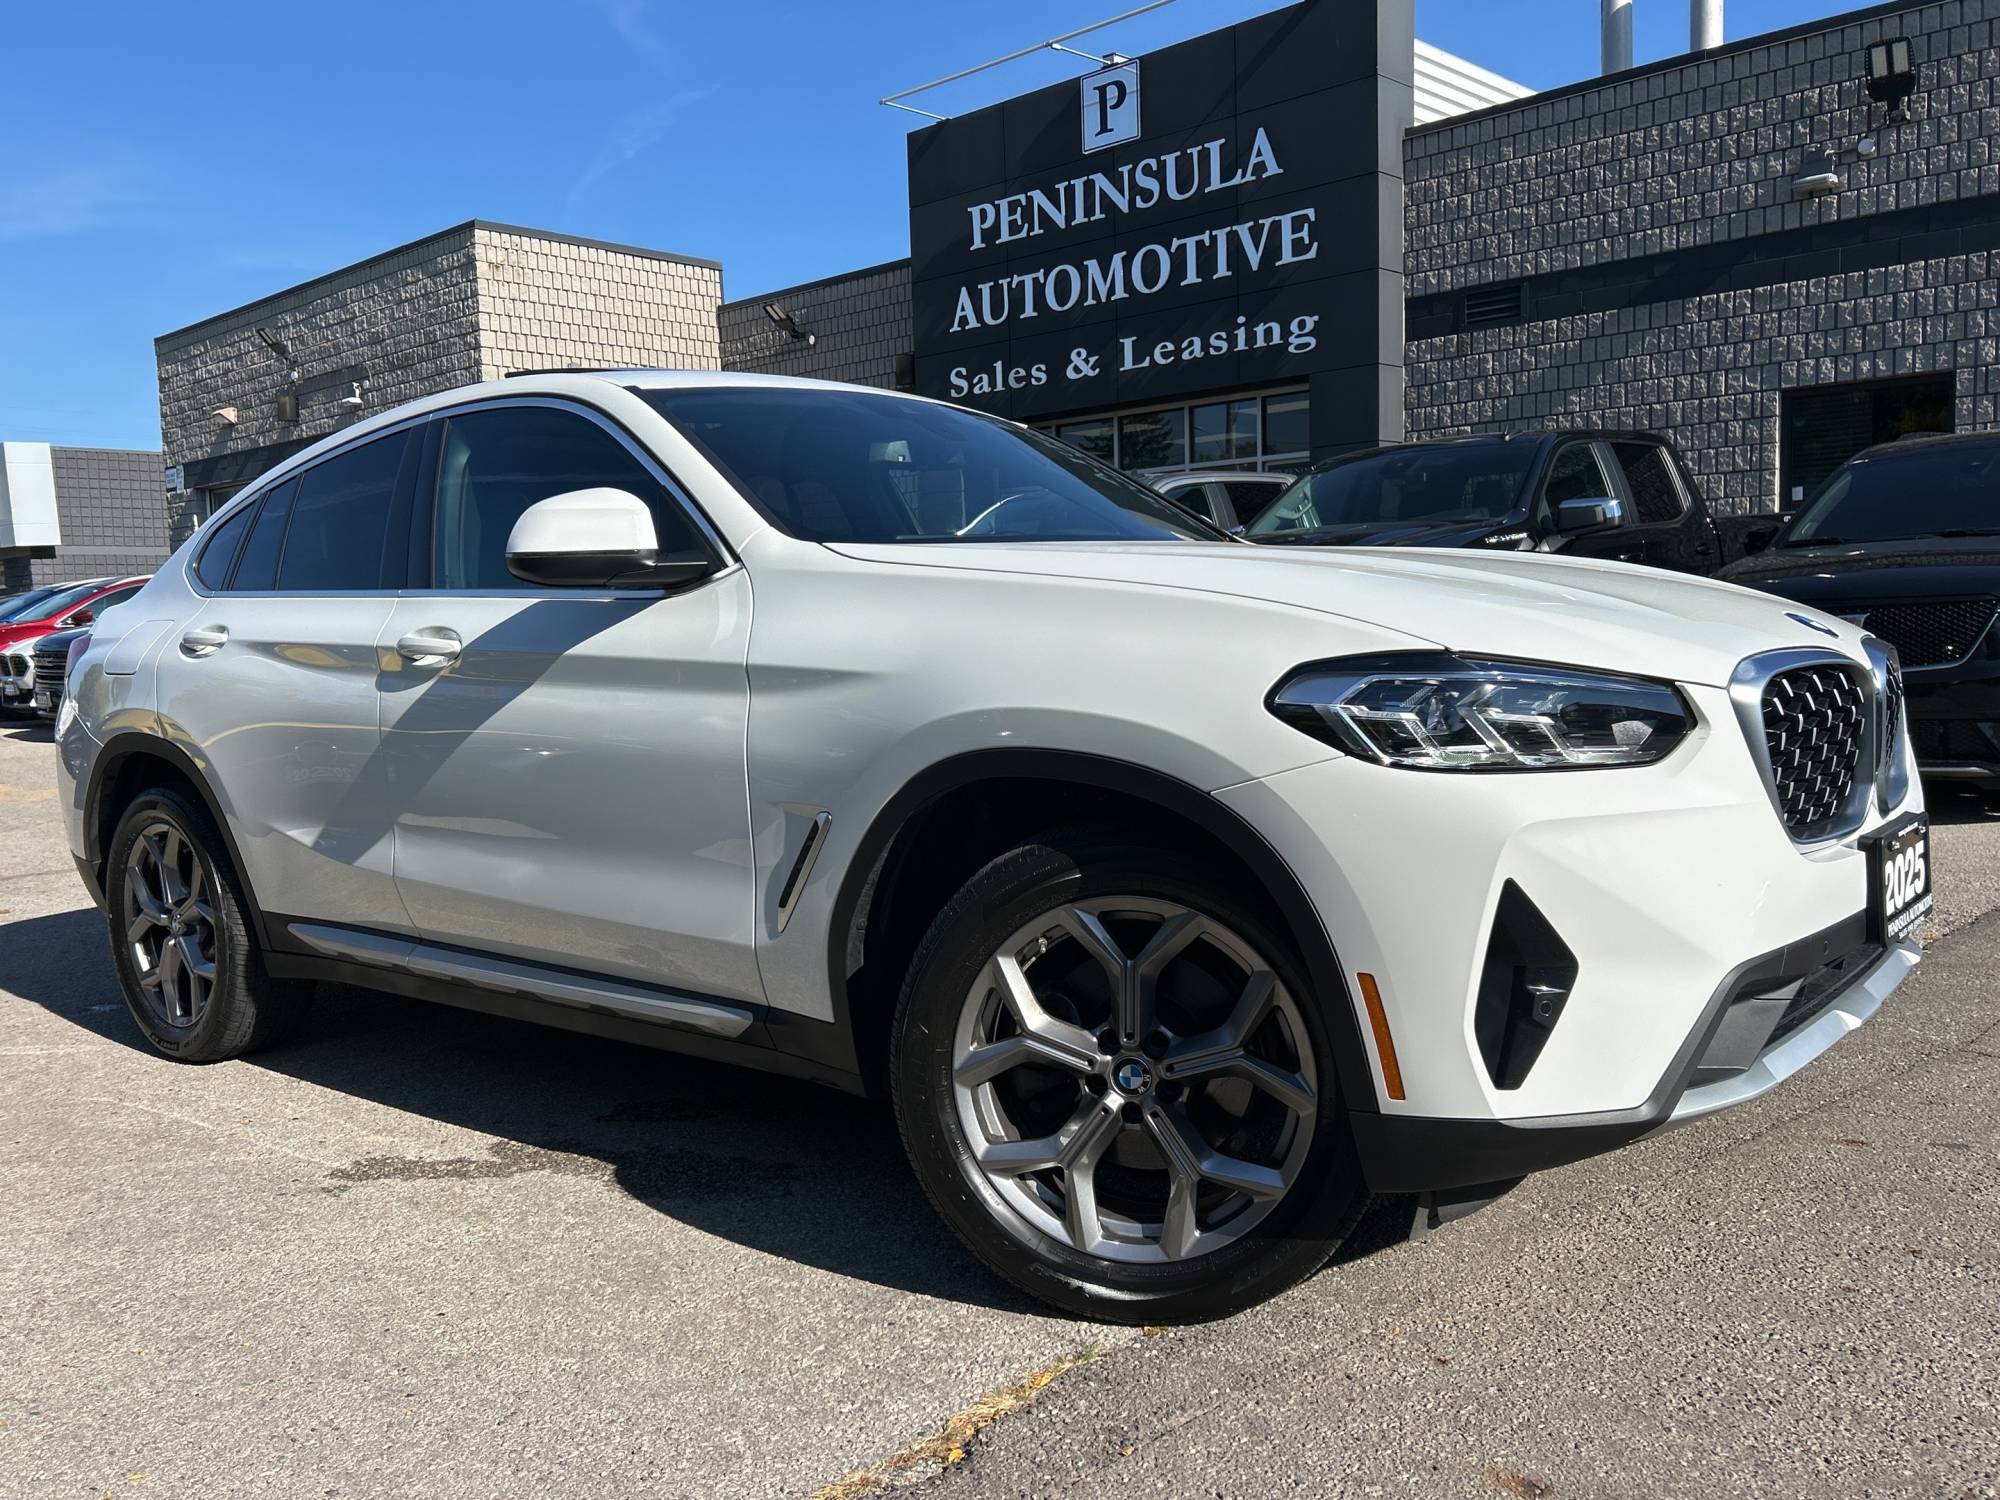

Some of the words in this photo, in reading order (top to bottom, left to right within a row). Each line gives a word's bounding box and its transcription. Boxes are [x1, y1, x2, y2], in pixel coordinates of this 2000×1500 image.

[1093, 78, 1128, 137] P
[967, 126, 1284, 251] PENINSULA
[949, 207, 1319, 333] AUTOMOTIVE
[950, 360, 1048, 399] Sales
[1065, 347, 1100, 381] &
[1119, 314, 1319, 372] Leasing
[1885, 840, 1925, 916] 2025
